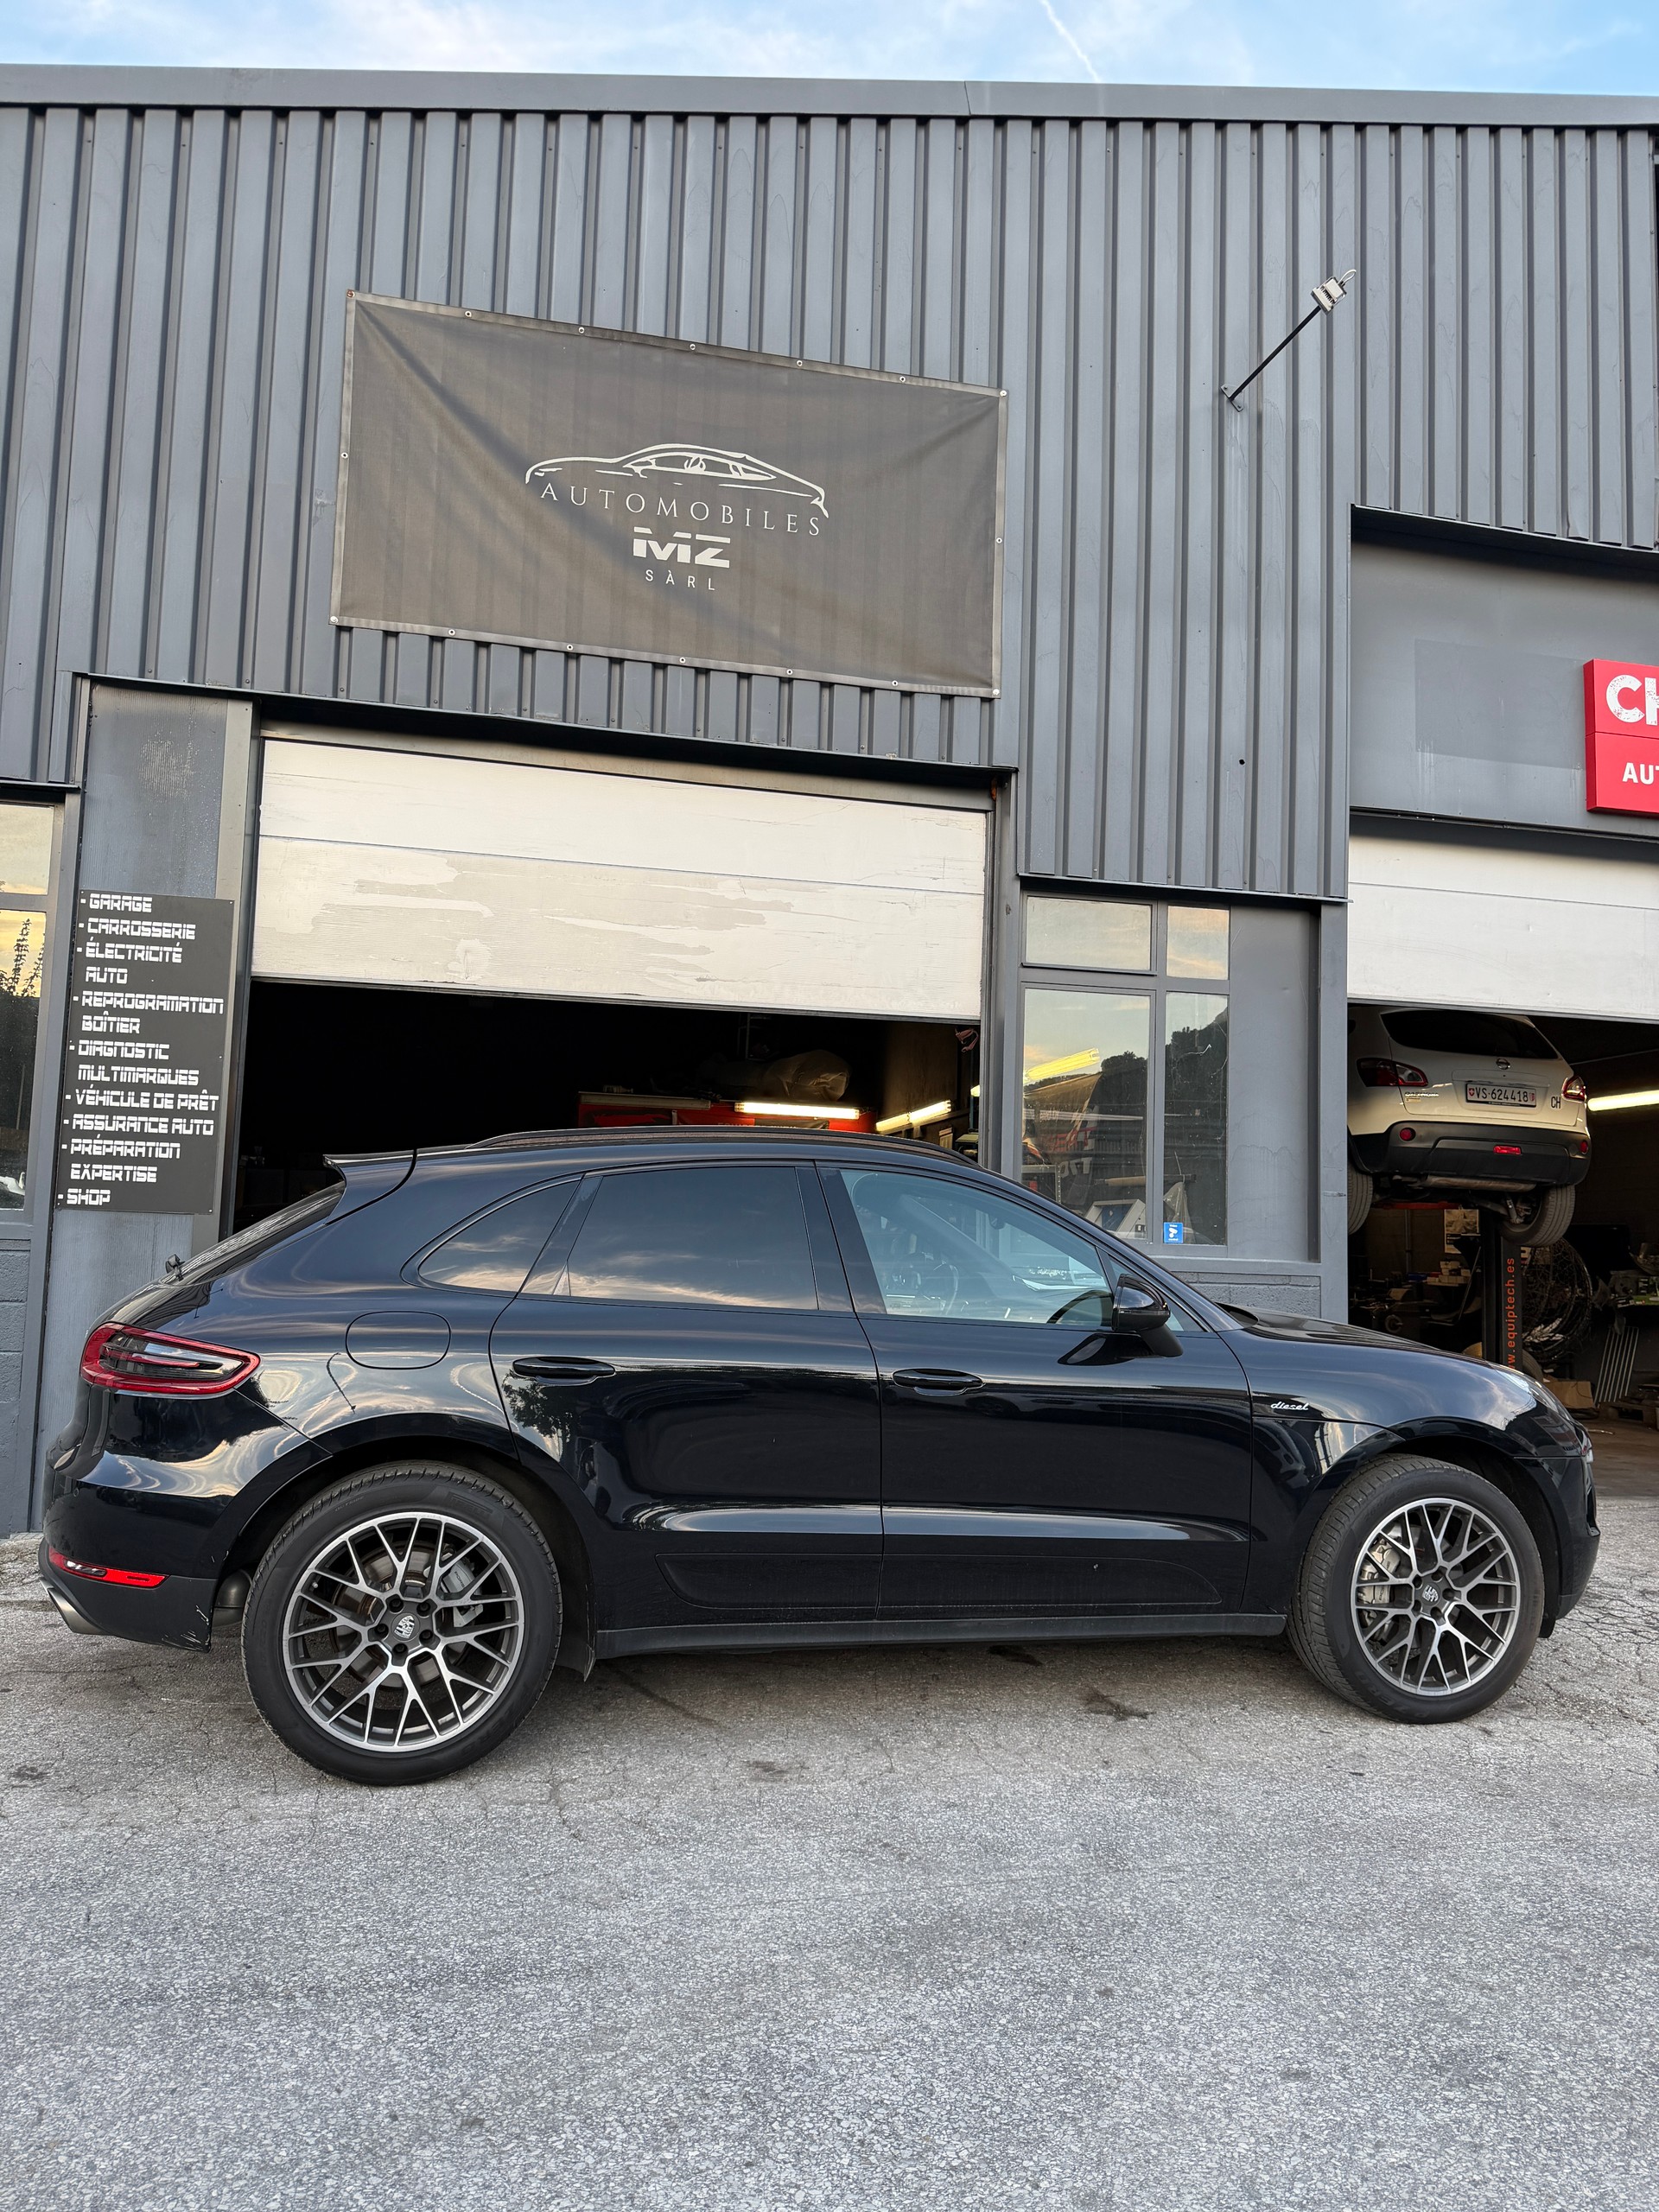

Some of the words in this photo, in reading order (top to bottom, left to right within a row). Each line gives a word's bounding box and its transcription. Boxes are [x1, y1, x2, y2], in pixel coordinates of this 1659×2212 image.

[540, 482, 820, 536] AUTOMOBILES
[632, 526, 731, 569] MZ
[645, 569, 715, 591] SÀRL
[1622, 762, 1659, 785] AU
[89, 893, 152, 913] GARAGE
[87, 918, 196, 940] CARROSSERIE
[86, 937, 182, 963] ÉLECTRICITÉ
[85, 967, 128, 984] AUTO
[81, 990, 224, 1014] REPROGRAMATION
[81, 1010, 141, 1034] BOÎTIER
[78, 1039, 170, 1060] DIAGNOSTIC
[78, 1064, 200, 1086] MULTIMARQUES
[75, 1084, 150, 1109] VÉHICULE
[153, 1092, 175, 1109] DE
[177, 1089, 219, 1111] PRÊT
[1551, 1096, 1560, 1109] CH
[72, 1113, 169, 1134] ASSURANCE
[171, 1118, 214, 1135] AUTO
[70, 1134, 181, 1159] PRÉPARATION
[70, 1163, 158, 1183] EXPERTISE
[67, 1188, 111, 1206] SHOP
[1270, 1401, 1309, 1411] diesel
